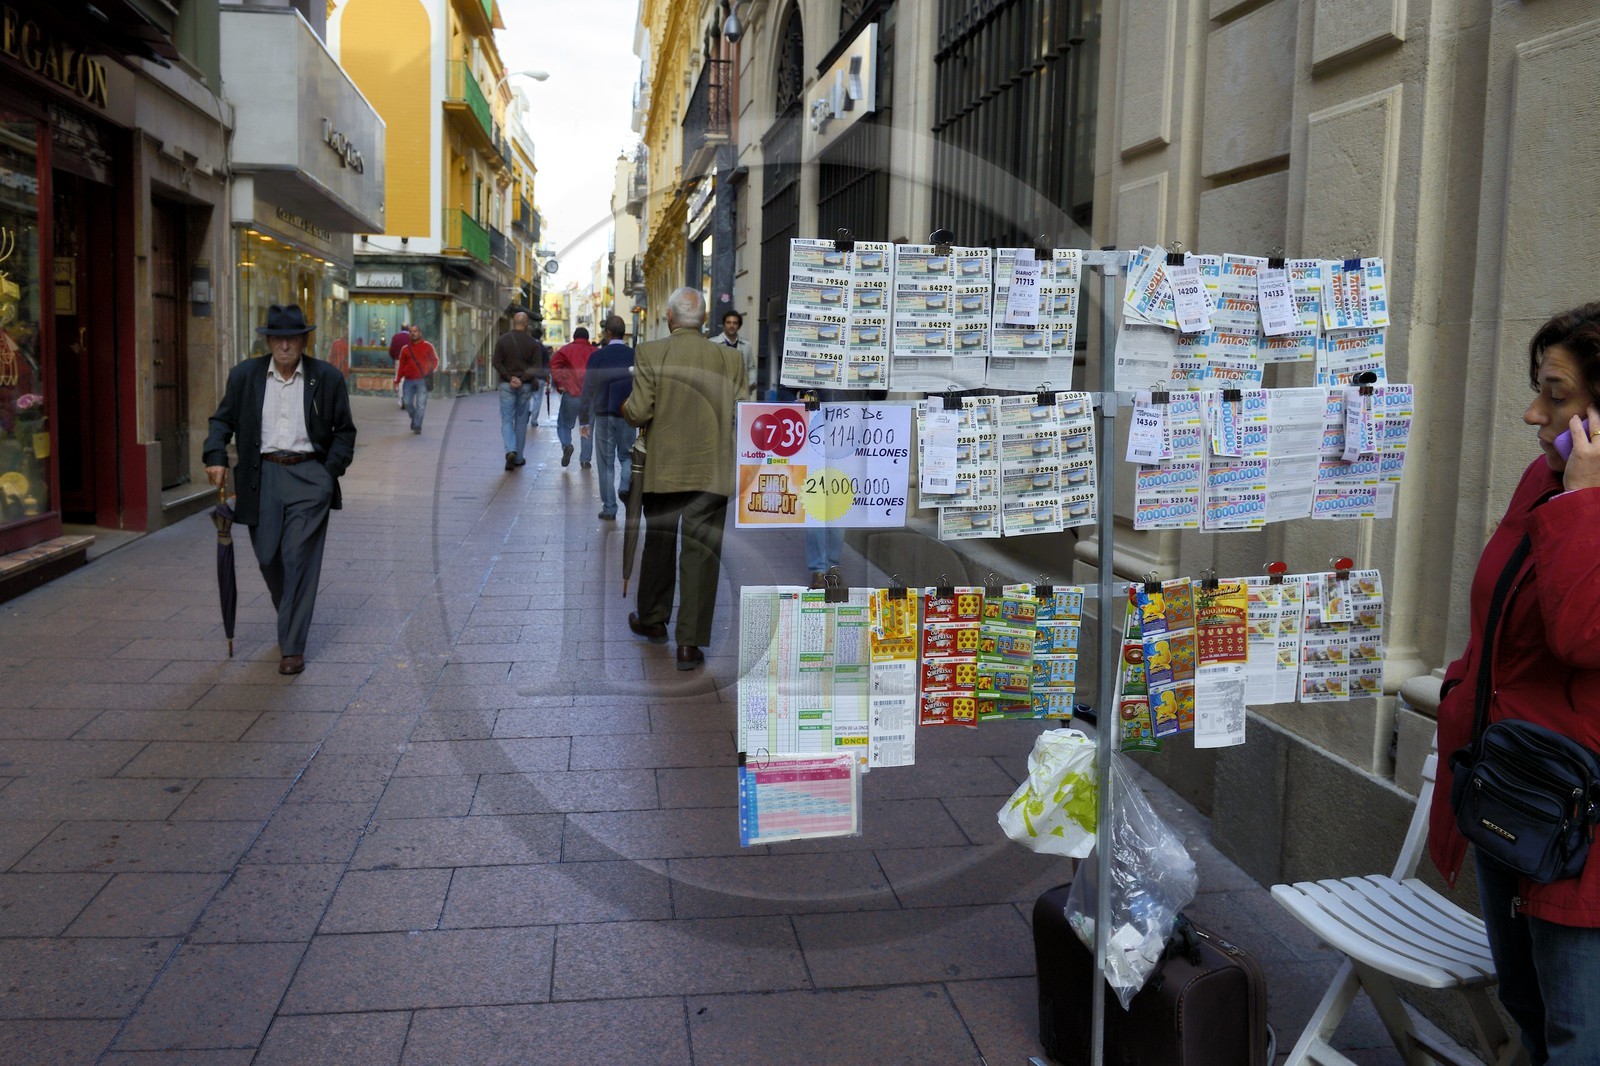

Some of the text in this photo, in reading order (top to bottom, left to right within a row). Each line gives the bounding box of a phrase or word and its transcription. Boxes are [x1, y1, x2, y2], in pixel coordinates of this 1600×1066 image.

[825, 278, 849, 286] 79560
[1178, 287, 1198, 295] 14200
[1264, 290, 1284, 298] 74133
[825, 407, 884, 421] MAS DE
[1136, 418, 1158, 427] 14369
[766, 419, 805, 447] 7 39
[1069, 426, 1092, 434] 50659
[1163, 428, 1171, 452] 52874
[746, 451, 766, 459] Lotto
[855, 448, 908, 457] MILLONES
[1070, 460, 1093, 468] 50659
[1320, 462, 1378, 479] 9.000.000€
[1140, 470, 1199, 489] 9.000.000€
[1208, 467, 1265, 486] 9.000.000€
[758, 474, 789, 493] EURO
[852, 498, 904, 506] MILLONES
[1072, 493, 1094, 501] 50659
[748, 493, 798, 514] JACKPOT
[1315, 495, 1374, 511] 9.000.000€
[1137, 504, 1197, 522] 9.000.000€
[1208, 502, 1264, 520] 9.000.000€
[1201, 607, 1239, 616] 400.000€
